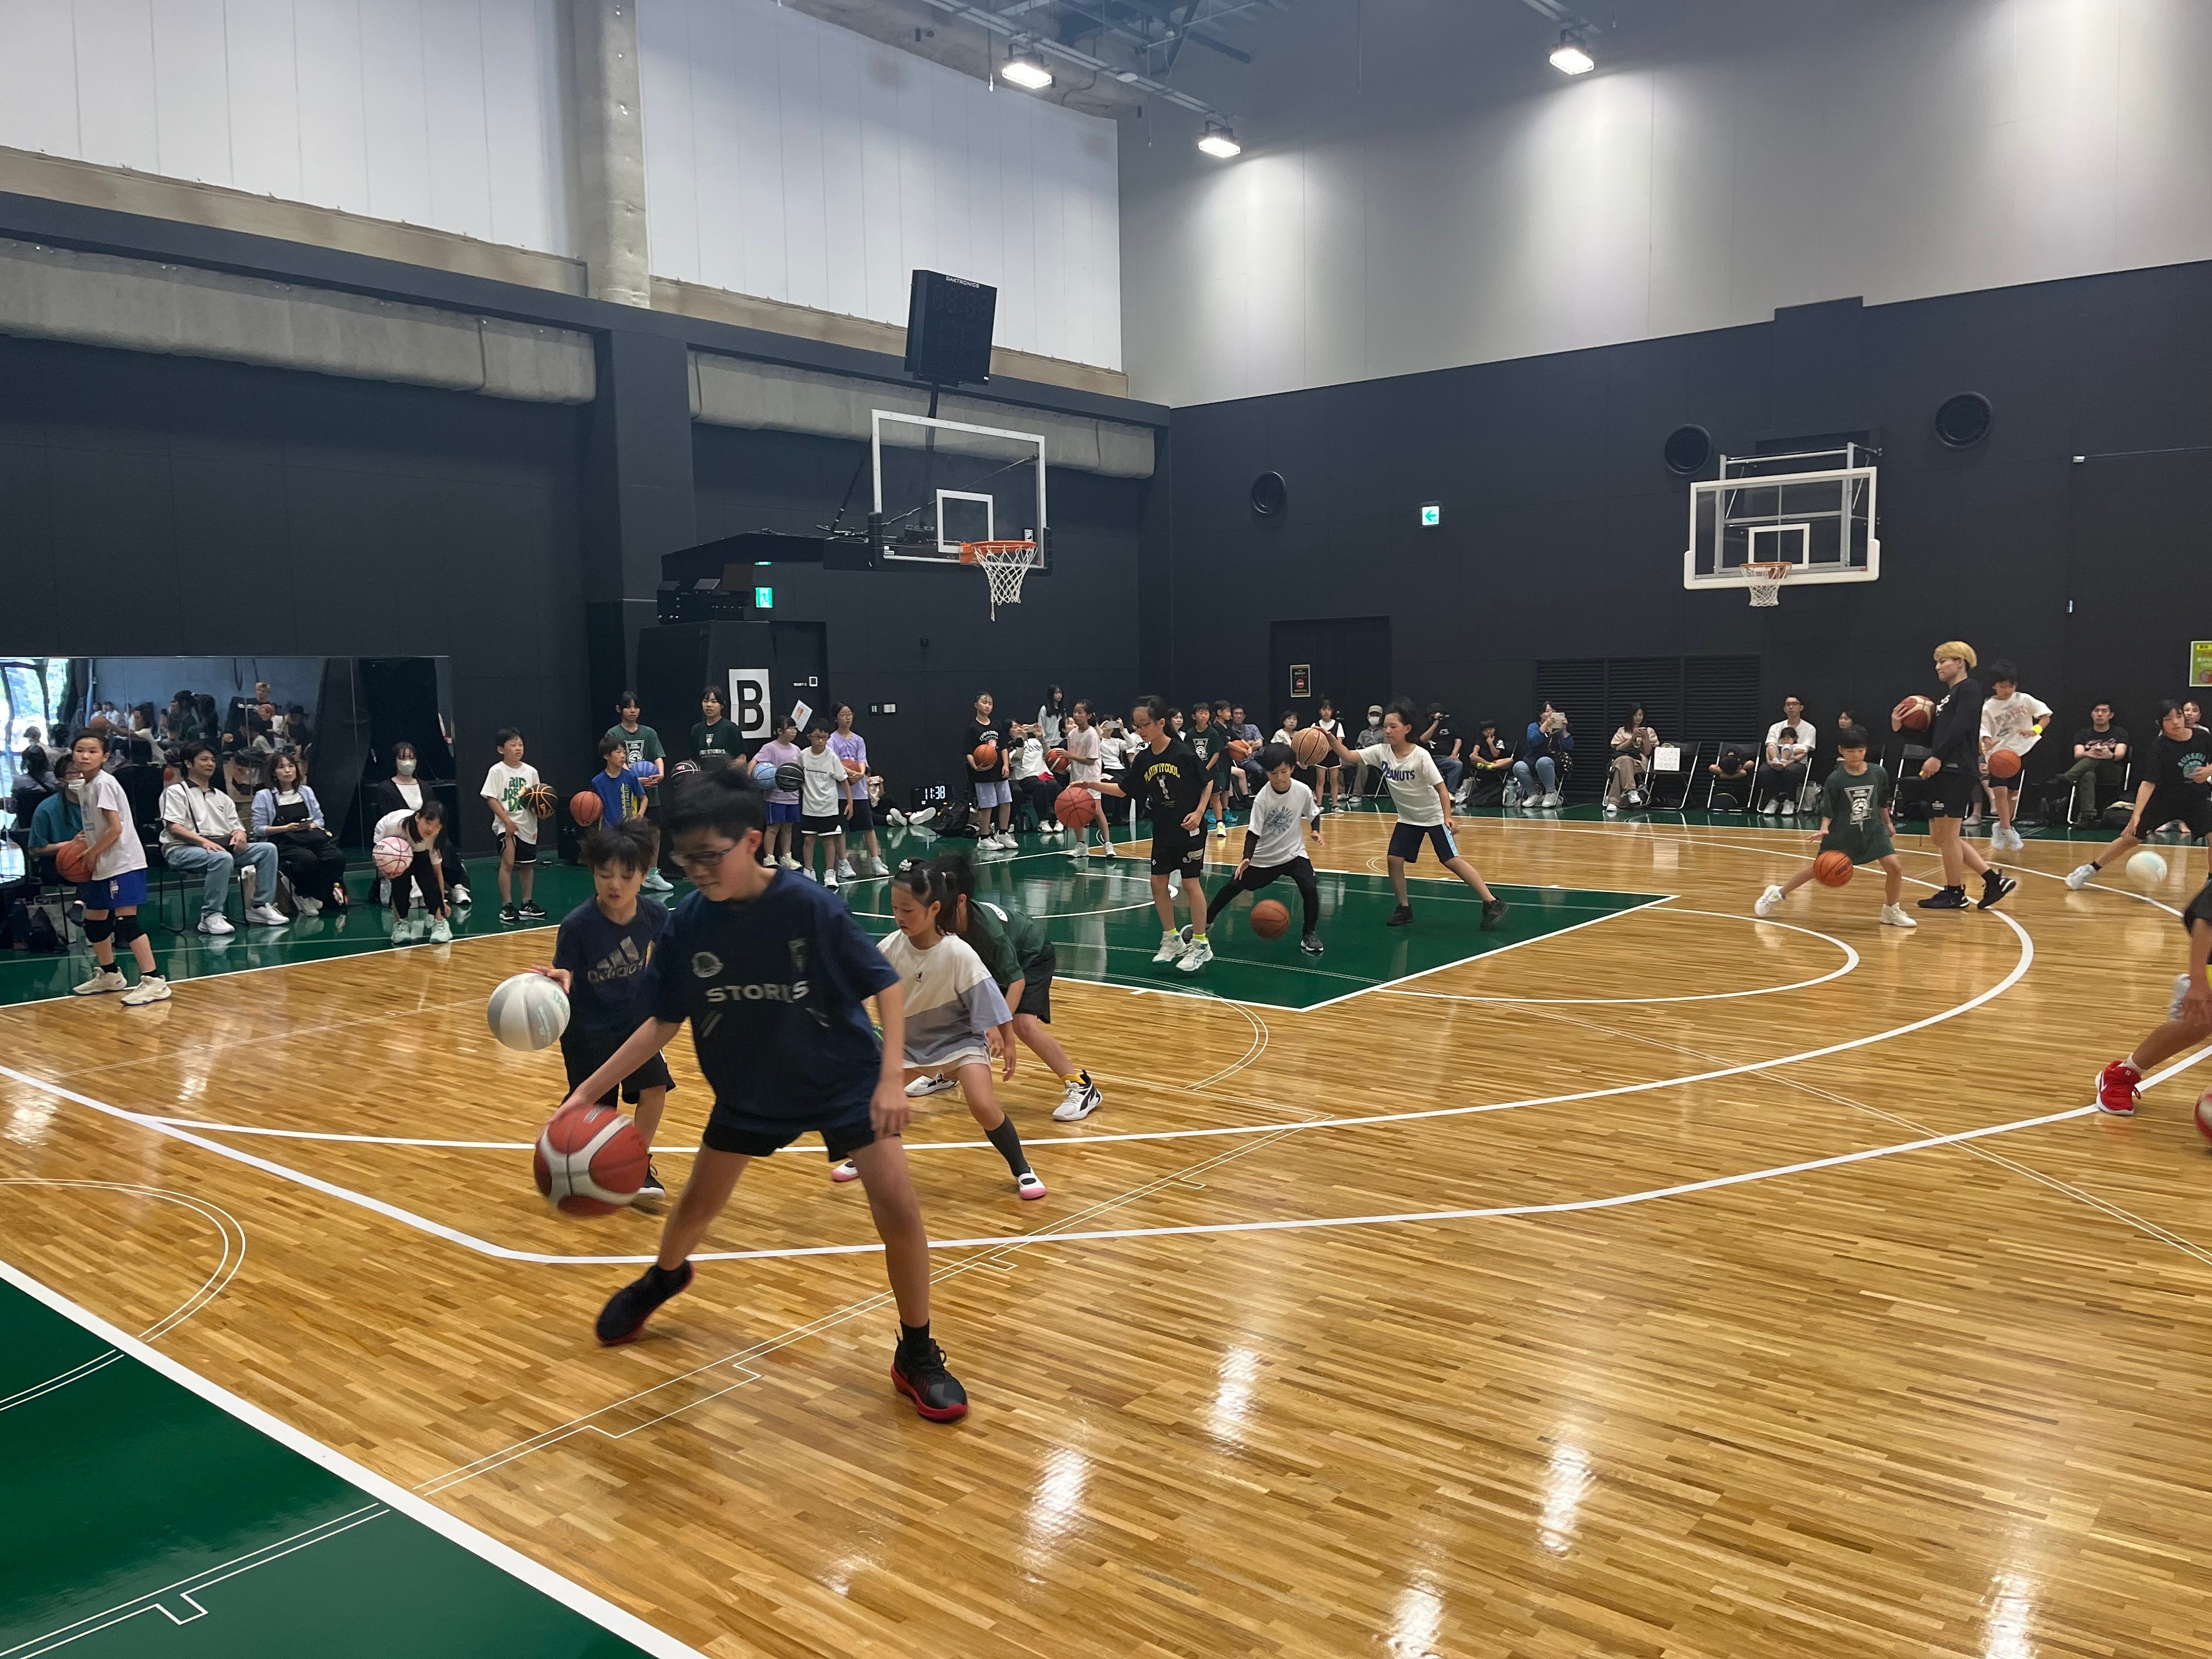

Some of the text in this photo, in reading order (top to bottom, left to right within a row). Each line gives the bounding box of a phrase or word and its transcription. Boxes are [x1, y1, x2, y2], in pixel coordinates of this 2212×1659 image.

[946, 276, 979, 288] DAKTRONICS
[736, 680, 764, 731] B
[1159, 763, 1165, 772] IT
[1165, 763, 1181, 778] COOL
[1382, 760, 1415, 781] PEANUTS
[925, 786, 945, 800] 11:38
